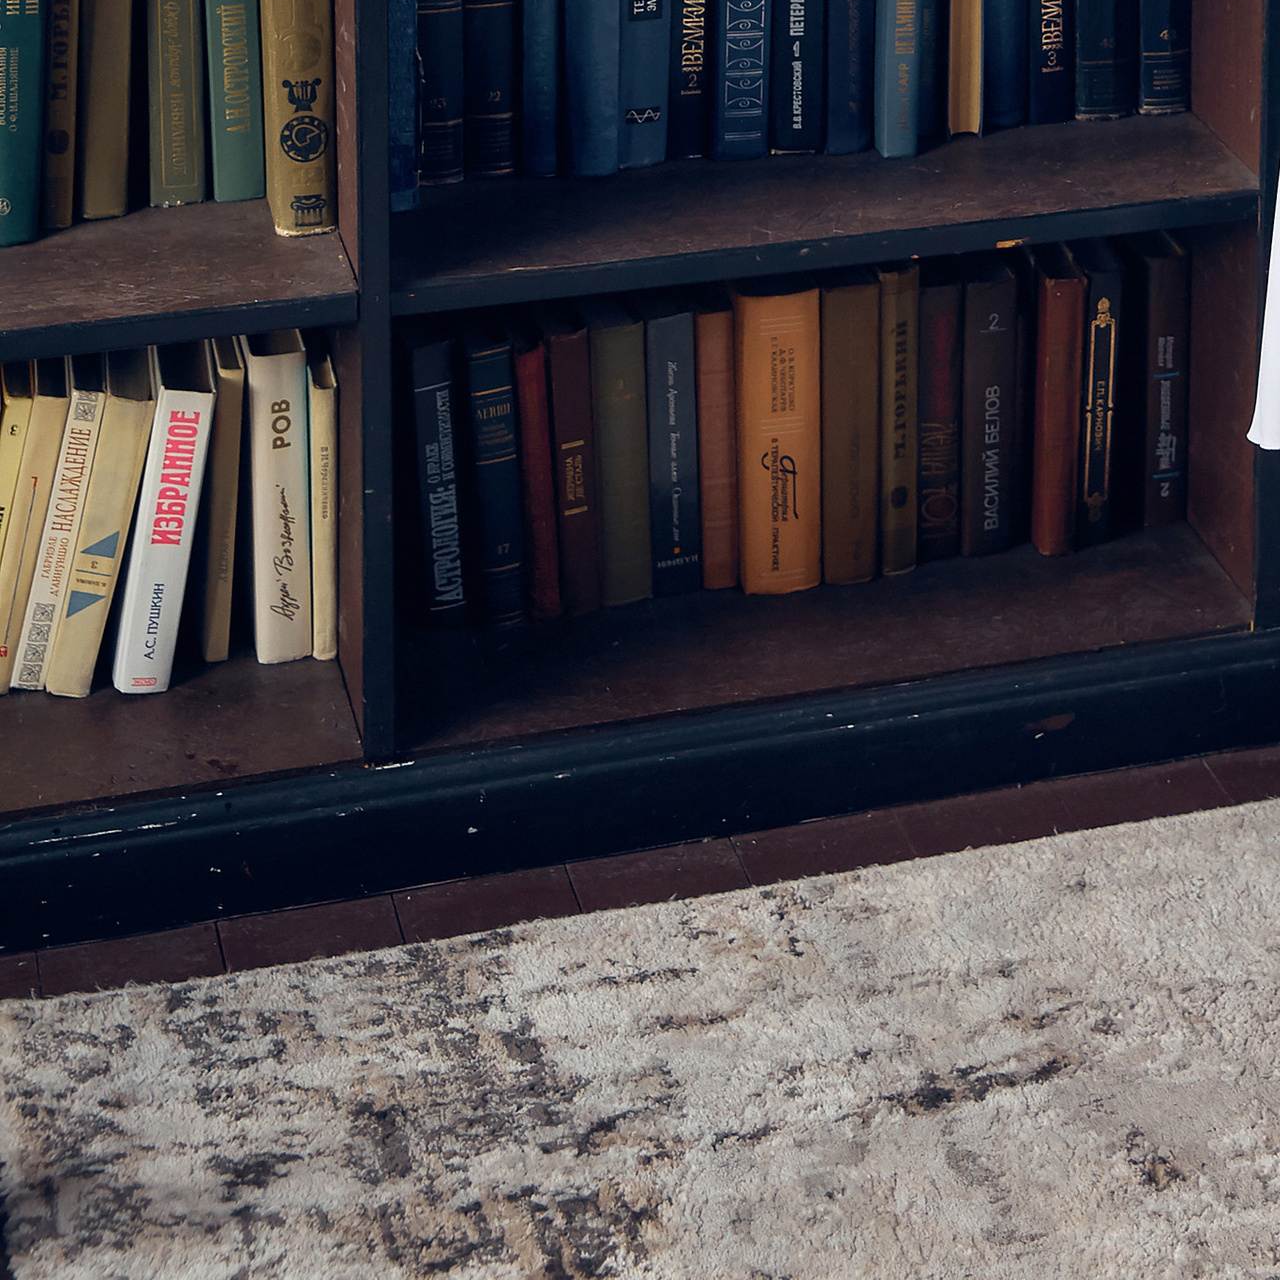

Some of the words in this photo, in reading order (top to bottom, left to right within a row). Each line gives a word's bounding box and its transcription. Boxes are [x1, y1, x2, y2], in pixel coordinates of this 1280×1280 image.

[271, 399, 293, 450] РОВ
[984, 385, 1000, 444] БЕЛОВ
[51, 427, 92, 533] НАСЛАЖДЕНИЕ
[150, 410, 200, 546] ИЗБРАННОЕ
[982, 448, 1000, 531] ВАСИЛИЙ
[40, 536, 58, 579] ГАБРИЭЛЕ
[147, 583, 165, 635] ПУШКИН
